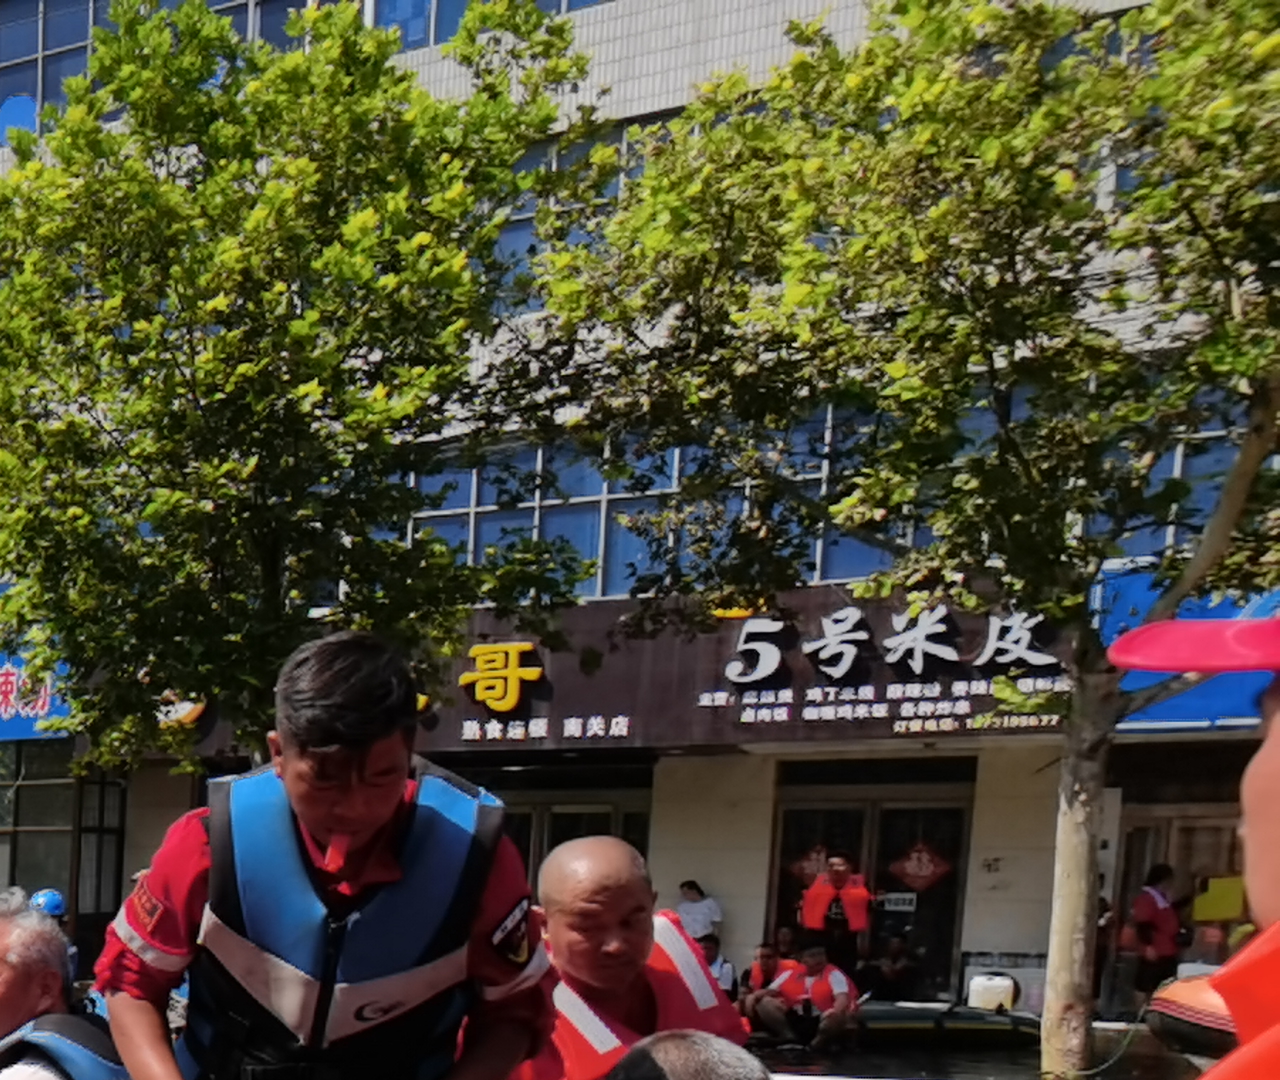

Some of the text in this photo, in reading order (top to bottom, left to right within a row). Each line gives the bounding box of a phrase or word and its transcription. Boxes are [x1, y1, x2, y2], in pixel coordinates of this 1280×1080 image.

[725, 604, 1058, 684] 5号米皮
[563, 714, 630, 739] 南关店
